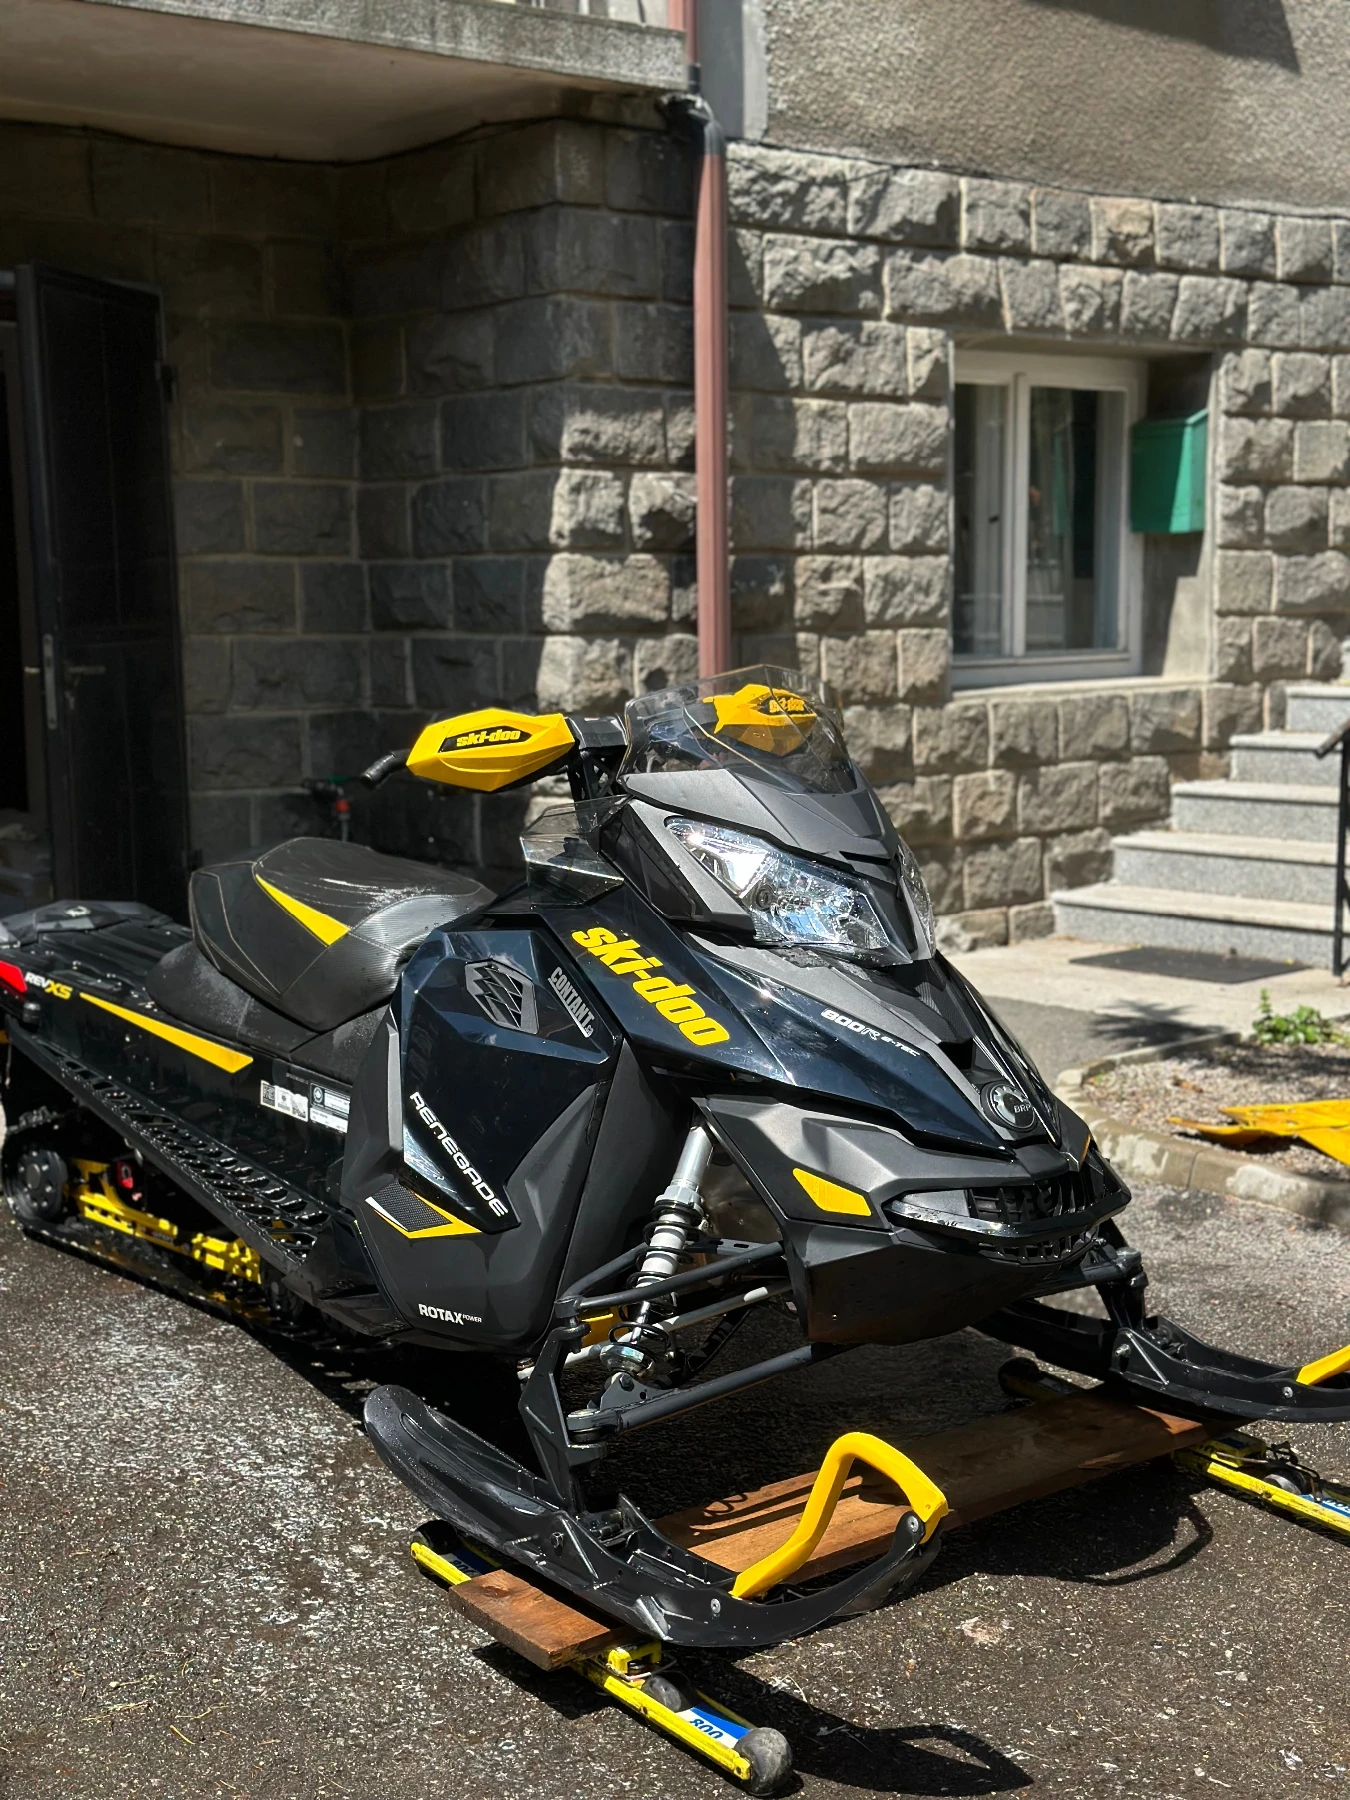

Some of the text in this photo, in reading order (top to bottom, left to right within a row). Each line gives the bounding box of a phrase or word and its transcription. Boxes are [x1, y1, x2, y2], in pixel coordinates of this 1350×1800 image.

[457, 729, 521, 747] ski-doo
[571, 926, 731, 1046] ski-doo
[1013, 1104, 1031, 1114] BRP
[409, 1091, 509, 1217] RENEGADE
[418, 1303, 483, 1326] ROTAX POWER
